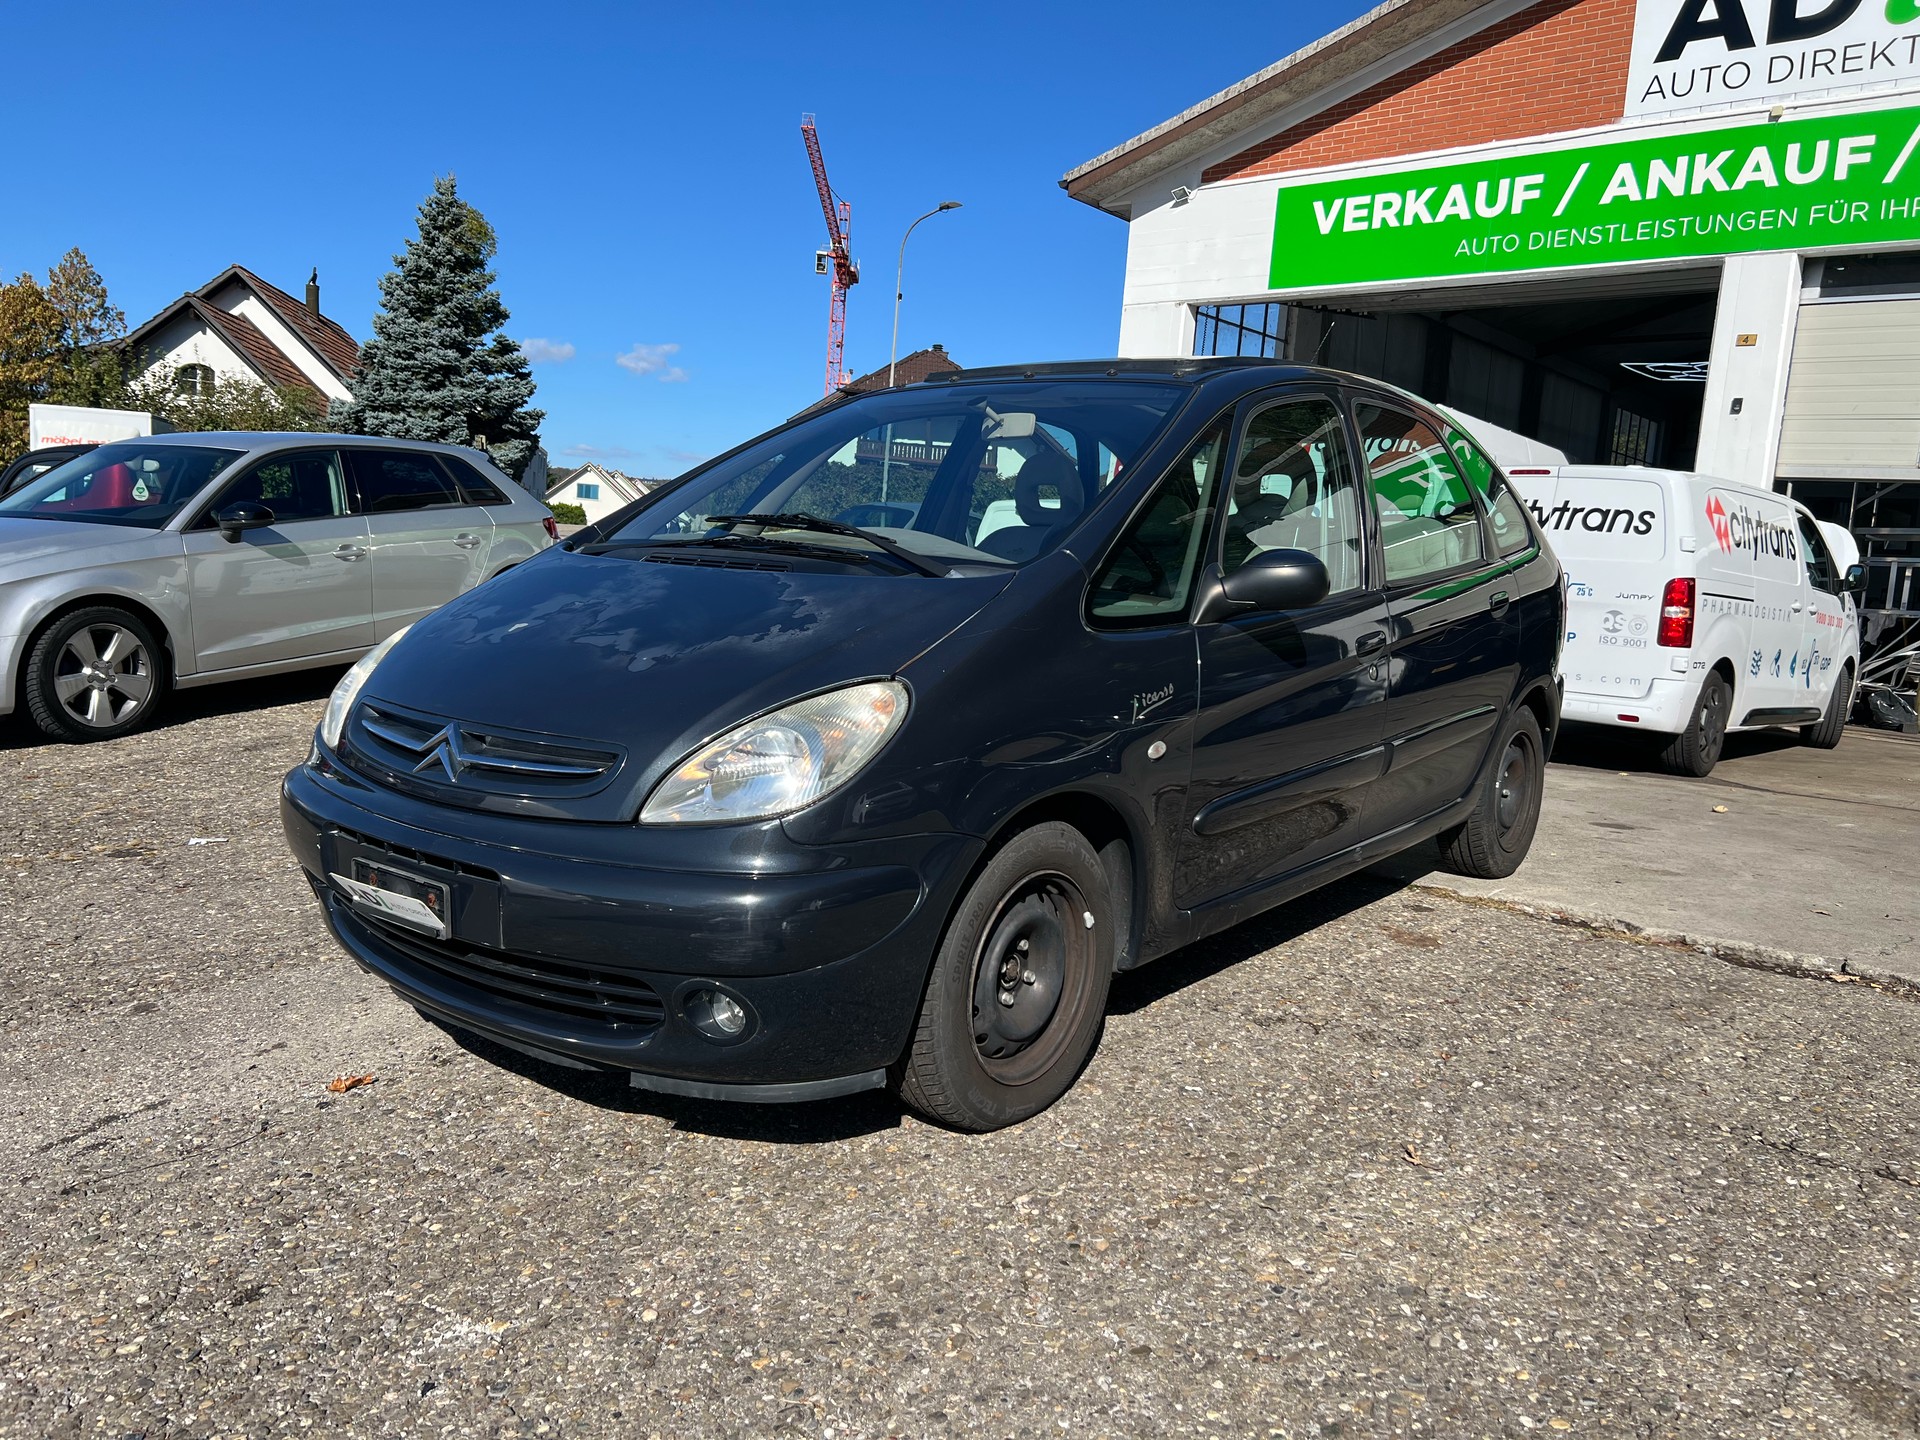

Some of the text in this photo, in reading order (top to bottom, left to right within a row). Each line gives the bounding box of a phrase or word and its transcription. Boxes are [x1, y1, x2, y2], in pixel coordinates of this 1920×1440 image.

[1641, 34, 1920, 103] AUTO DIREKT
[1313, 174, 1545, 235] VERKAUF
[1599, 134, 1877, 206] ANKAUF
[1454, 233, 1521, 258] AUTO
[1528, 207, 1798, 251] DIENSTLEISTUNGEN
[1809, 198, 1869, 226] FÜR
[1730, 505, 1797, 561] citytrans
[1702, 598, 1792, 623] PHARMALOGISTIK
[1599, 635, 1647, 648] ISO 9001
[951, 901, 984, 985] SPIRIT PRO
